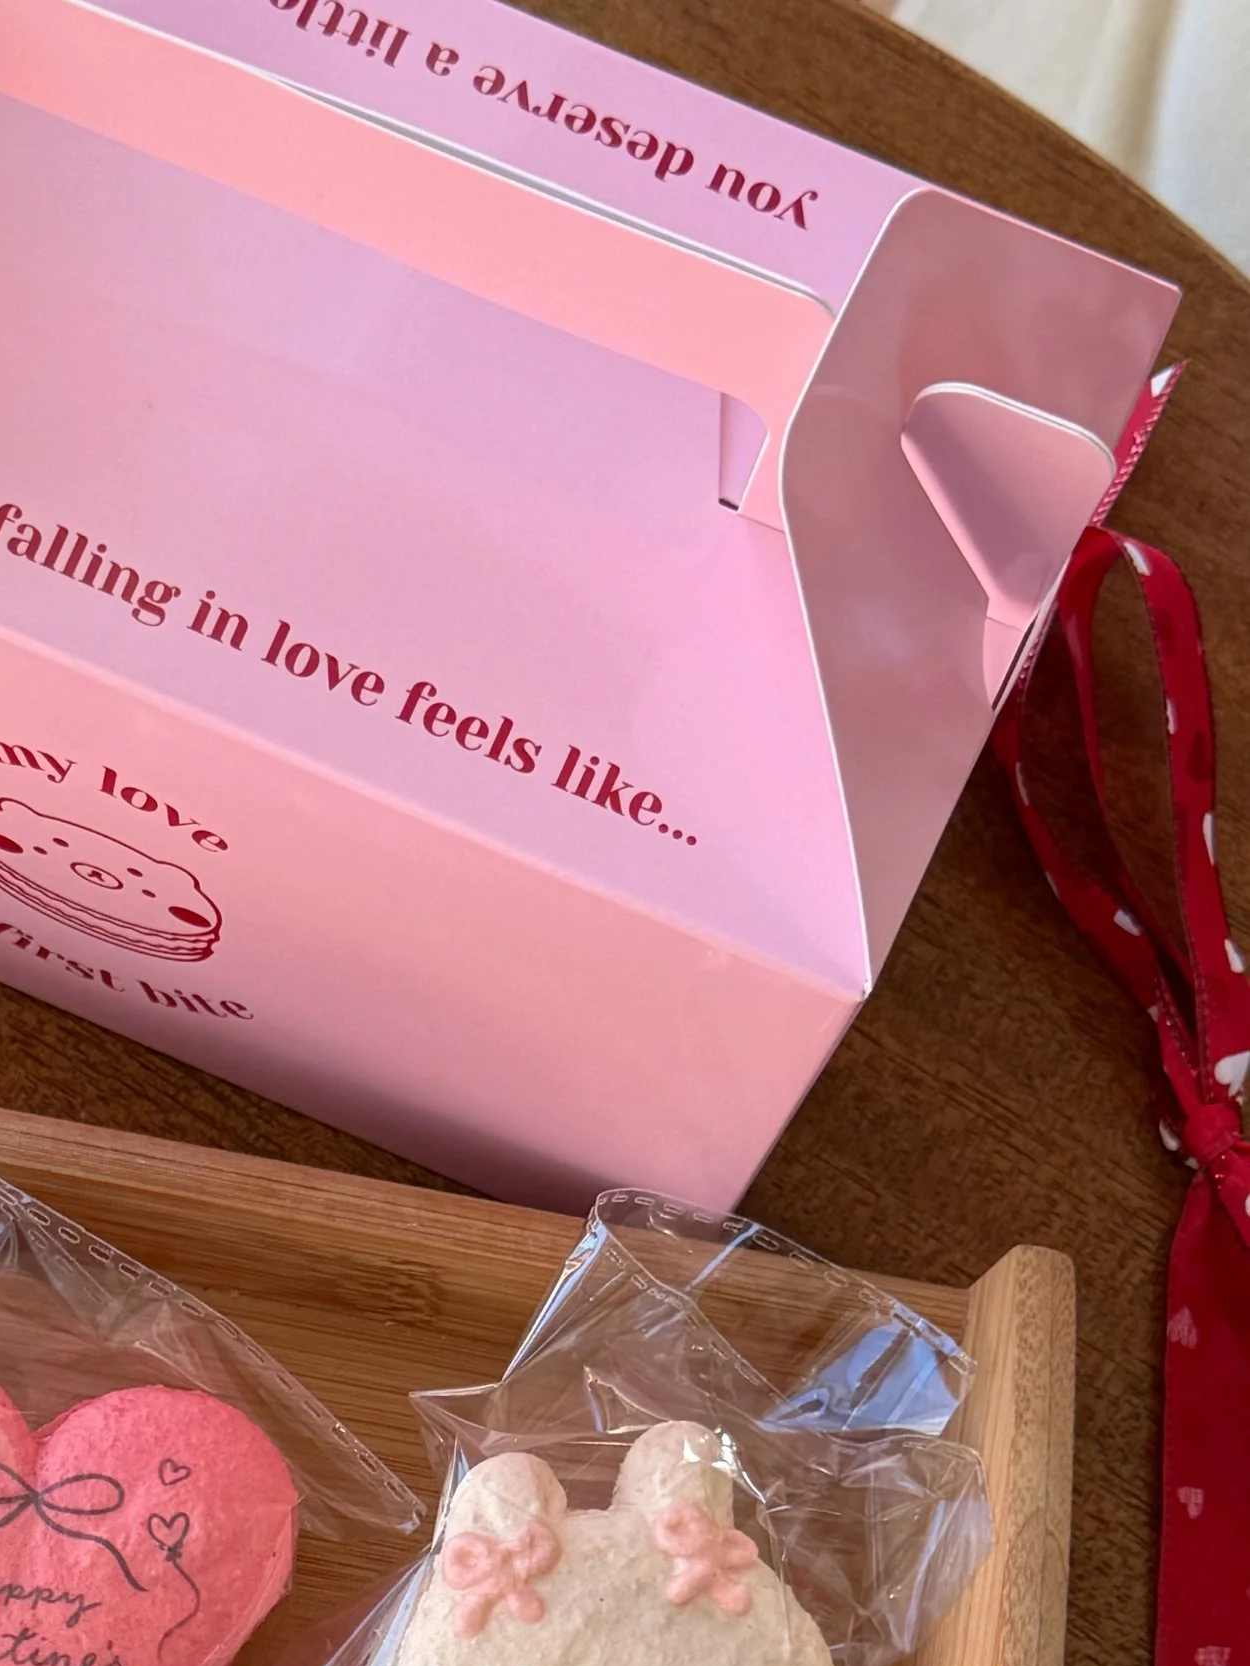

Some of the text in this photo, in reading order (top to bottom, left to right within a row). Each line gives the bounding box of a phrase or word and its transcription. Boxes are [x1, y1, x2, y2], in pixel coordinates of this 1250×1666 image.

[269, 0, 818, 231] you deserve a littl
[187, 590, 249, 651] in
[261, 620, 386, 707] love
[395, 681, 543, 775] feels
[551, 745, 699, 848] like...
[100, 765, 230, 853] love
[137, 979, 255, 1021] bite
